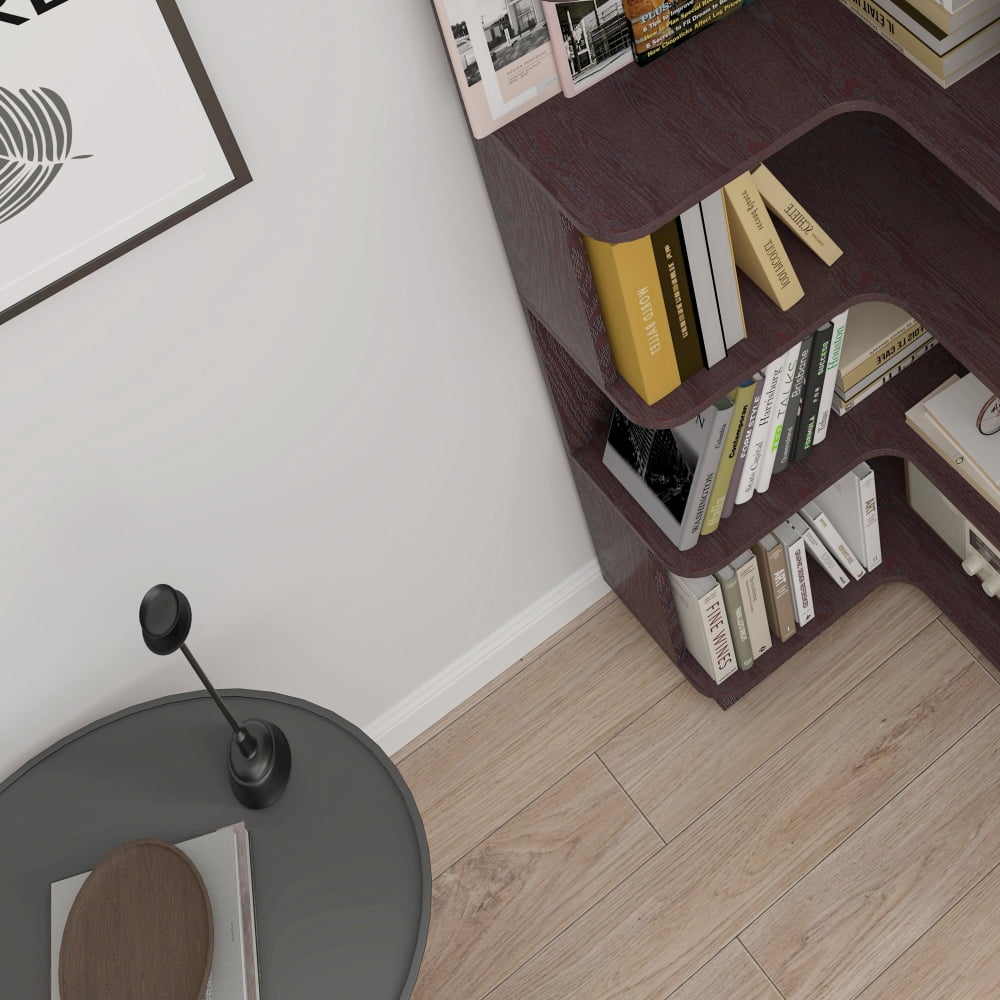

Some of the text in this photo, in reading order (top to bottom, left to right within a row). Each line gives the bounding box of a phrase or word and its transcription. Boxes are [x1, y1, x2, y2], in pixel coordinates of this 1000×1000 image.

[640, 2, 672, 24] PLUS:
[644, 30, 658, 41] How
[666, 18, 680, 28] Plan
[680, 5, 701, 20] Special
[648, 18, 662, 29] Tips
[670, 0, 694, 18] Improve
[651, 30, 675, 45] Secrets
[682, 18, 691, 27] Fit
[692, 7, 711, 22] Dream
[888, 23, 895, 35] IL
[647, 46, 661, 57] How
[694, 15, 711, 30] Affect
[827, 325, 845, 371] Houston
[791, 349, 809, 399] Brisbane
[759, 366, 783, 428] Harrisburg
[740, 394, 761, 459] FORM STYLE
[745, 441, 764, 493] State Capital
[691, 472, 714, 534] WASHINGTON
[706, 601, 724, 633] FINE
[712, 629, 732, 671] WINES
